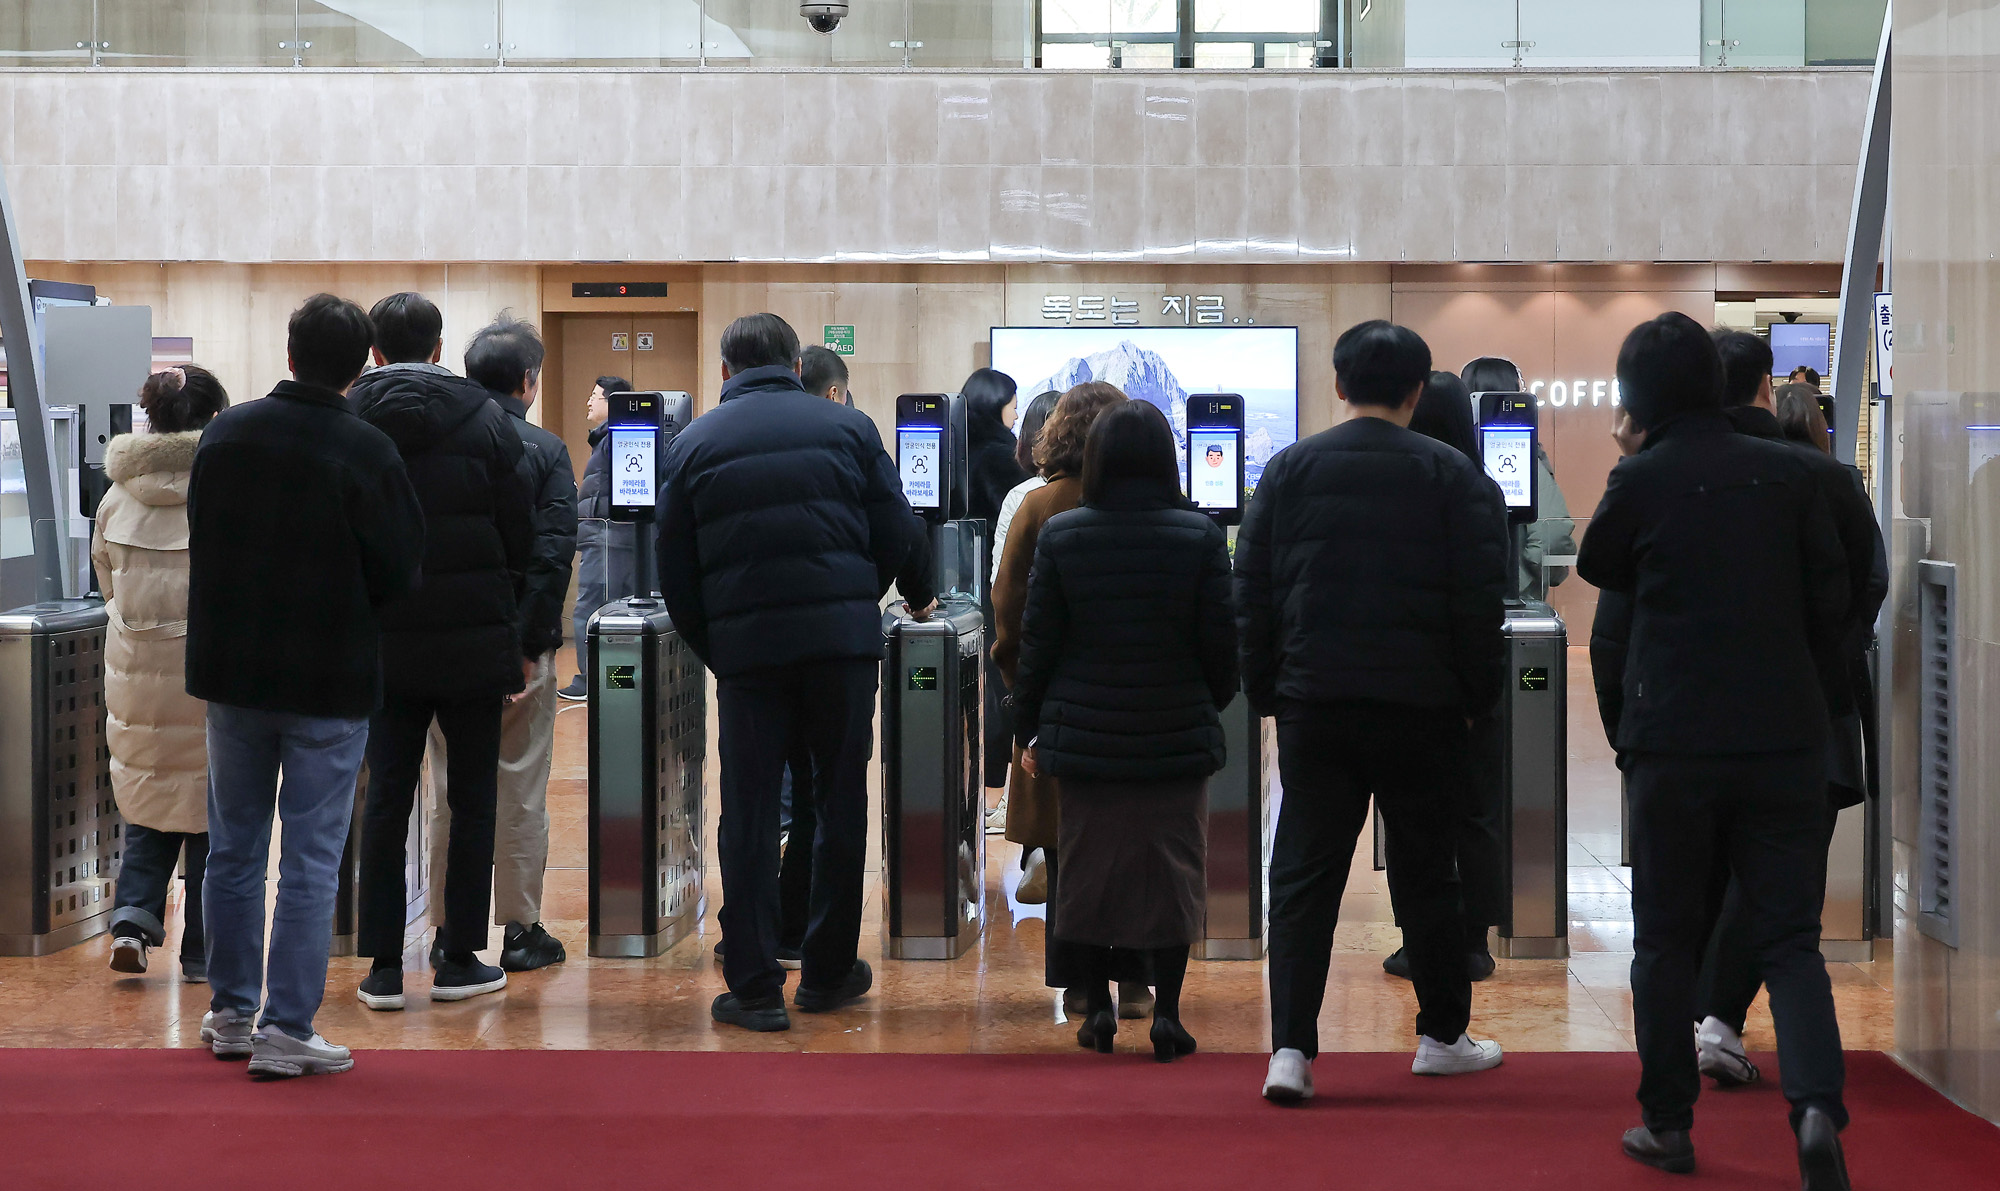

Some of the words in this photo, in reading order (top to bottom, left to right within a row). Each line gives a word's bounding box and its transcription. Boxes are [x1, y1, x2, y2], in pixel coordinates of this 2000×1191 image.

[620, 286, 627, 294] 3
[1041, 295, 1139, 325] 독도는
[836, 344, 854, 352] AED
[622, 480, 646, 488] 카메라를
[908, 481, 931, 489] 카메라를
[1497, 480, 1520, 488] 메라를
[619, 488, 649, 496] 바라보세요
